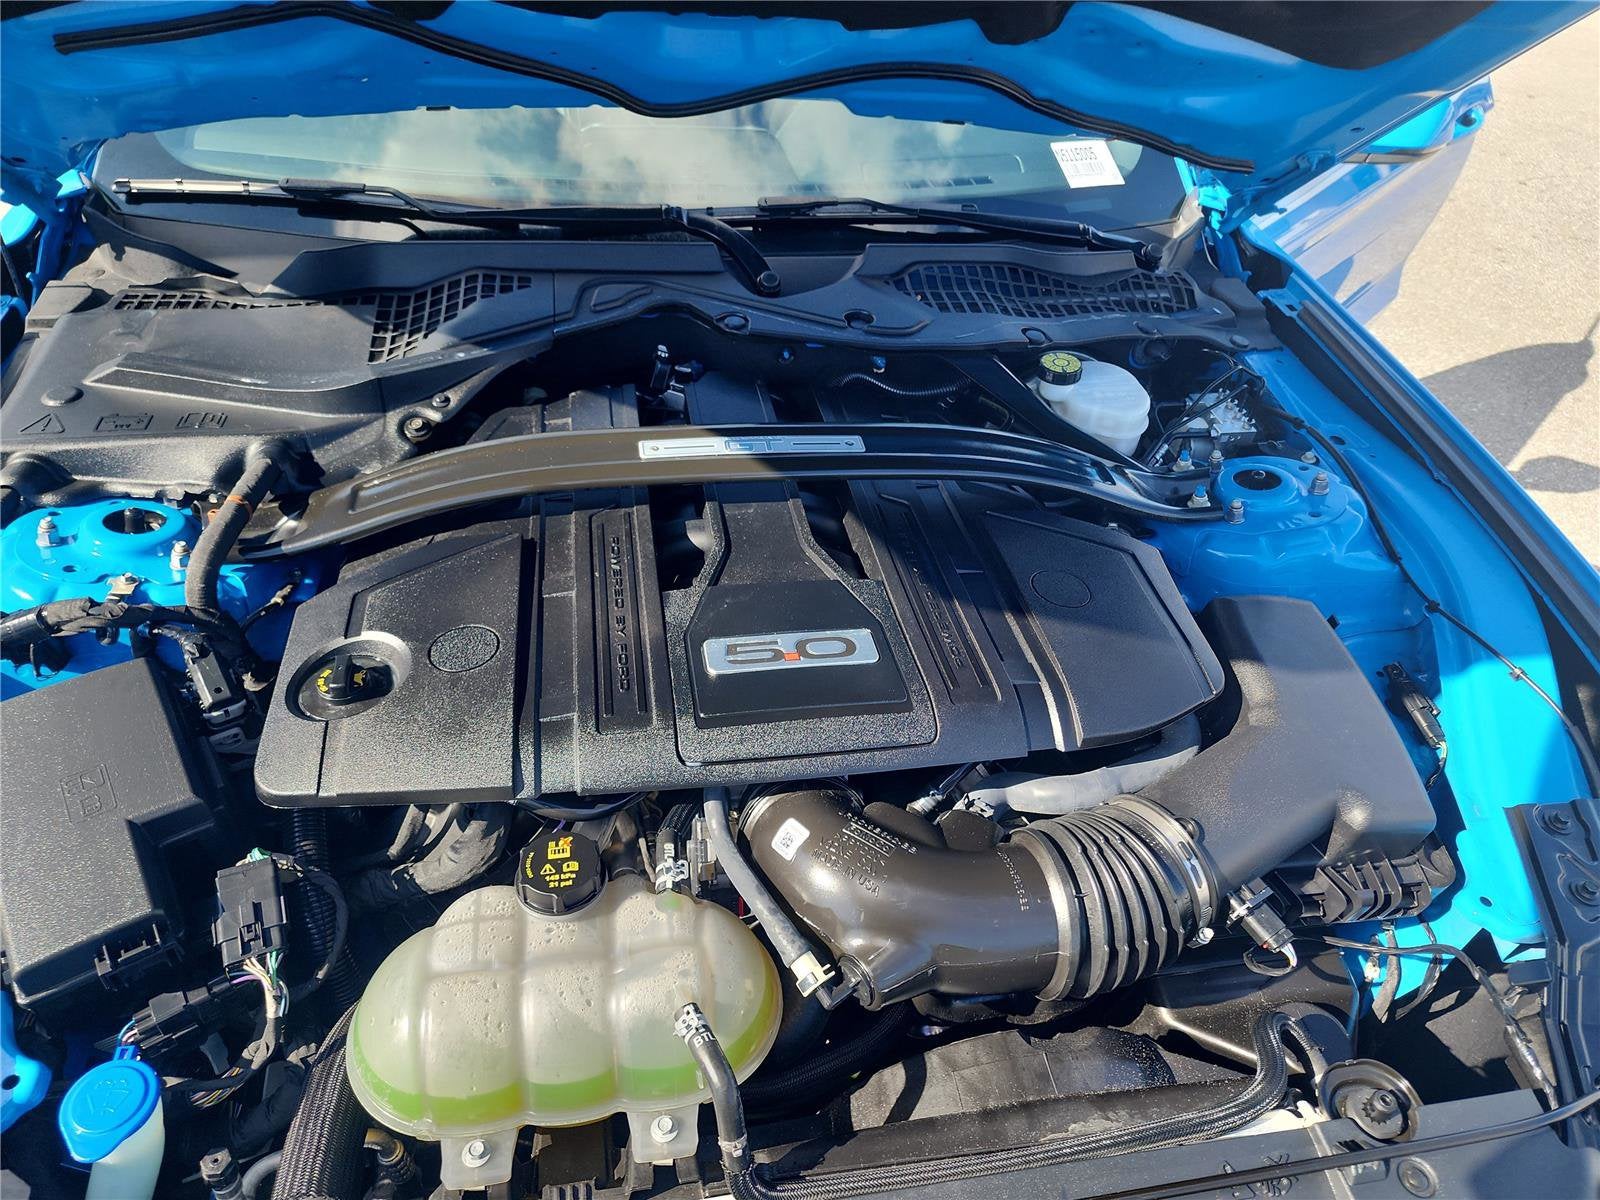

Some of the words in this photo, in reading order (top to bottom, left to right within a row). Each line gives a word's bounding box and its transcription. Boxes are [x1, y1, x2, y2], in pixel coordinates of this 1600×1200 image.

[725, 437, 783, 452] GT
[610, 536, 625, 609] POWERED
[615, 615, 627, 637] BY
[725, 636, 857, 665] 5.0
[617, 643, 630, 692] FORD
[858, 874, 881, 898] USA
